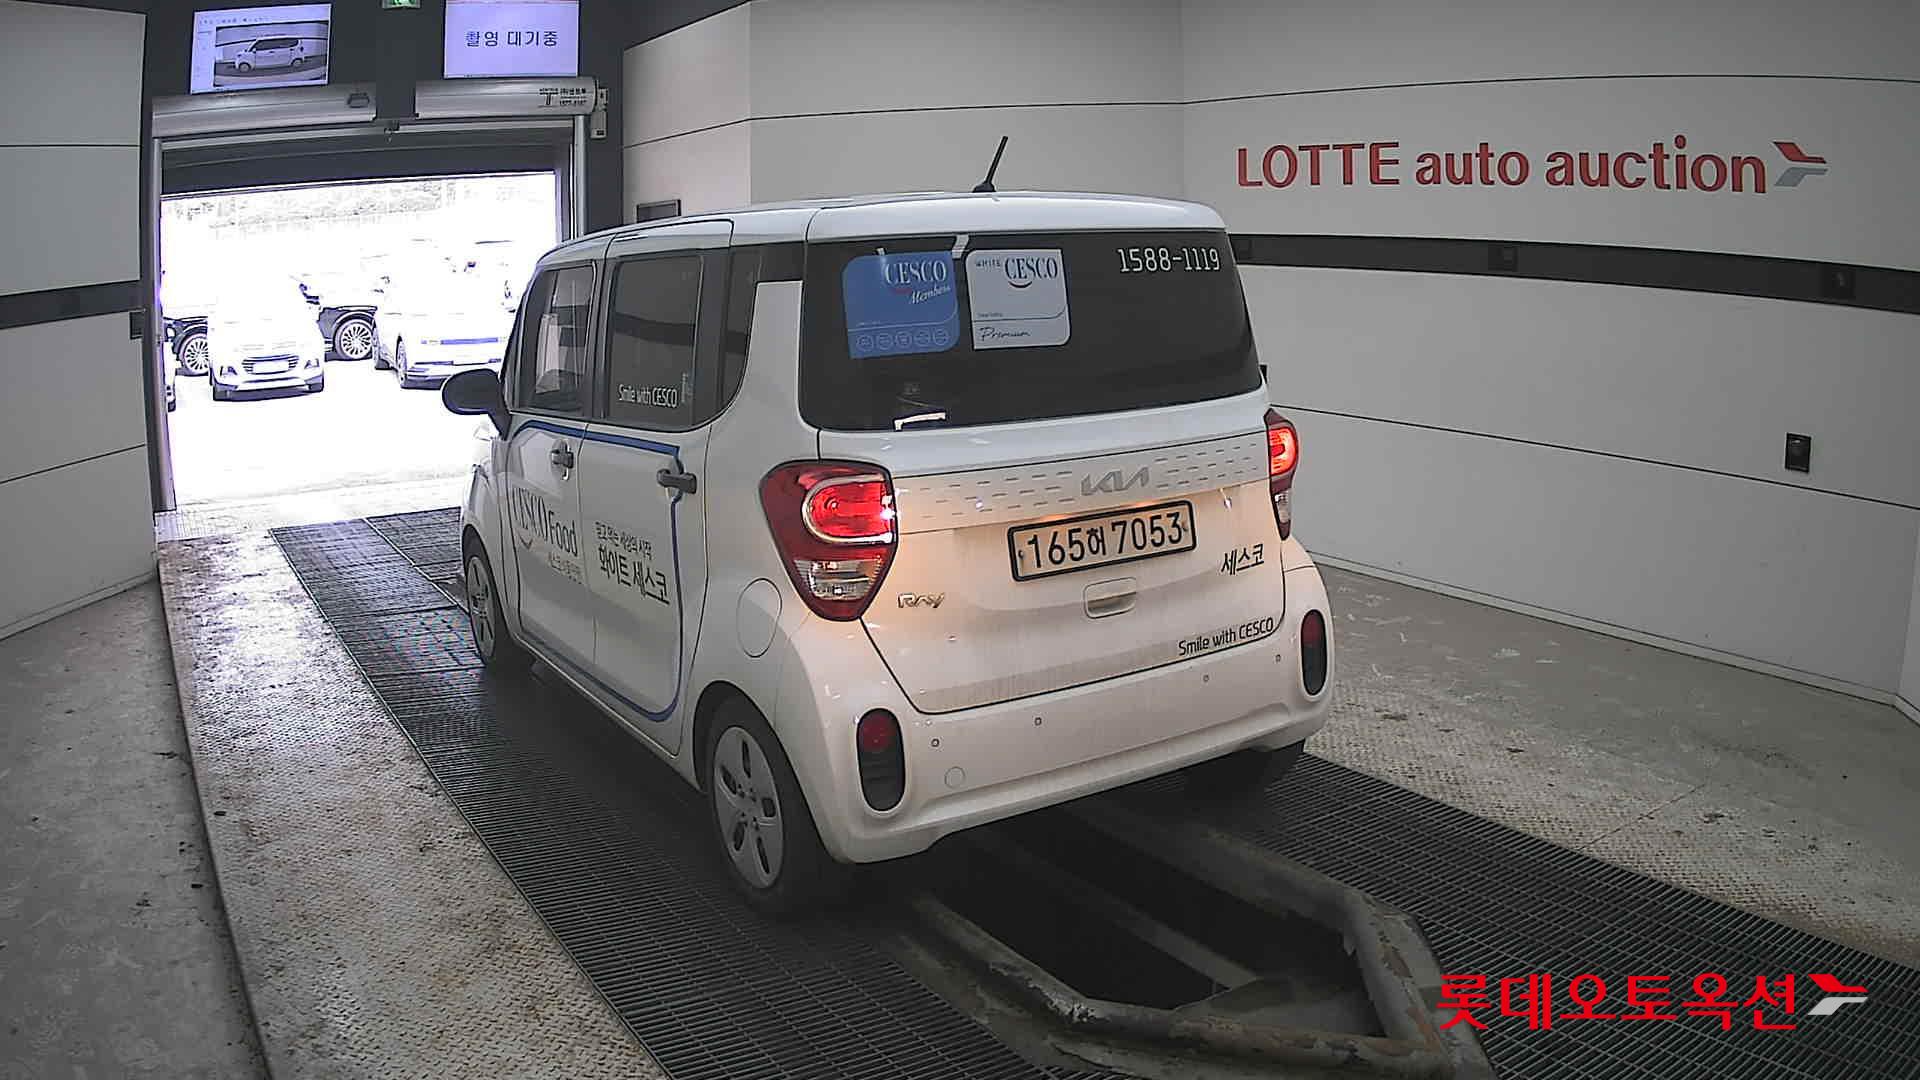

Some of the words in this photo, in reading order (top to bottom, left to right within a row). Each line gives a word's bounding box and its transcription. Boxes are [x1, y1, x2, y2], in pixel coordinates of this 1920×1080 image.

[507, 31, 558, 47] 대기중
[1237, 142, 1400, 188] LOTTE
[1415, 142, 1529, 186] auto
[1545, 134, 1767, 194] auction
[884, 260, 947, 284] CESCO
[1005, 257, 1058, 279] CESCO
[1117, 247, 1220, 272] 1588-1119
[652, 387, 678, 408] CESCO
[548, 510, 577, 557] Food
[1220, 543, 1264, 575] 세스코
[598, 543, 632, 587] 화이트
[633, 560, 671, 605] 세스코
[1178, 636, 1210, 656] Smile
[1212, 628, 1237, 647] with
[1239, 617, 1274, 640] CESCO
